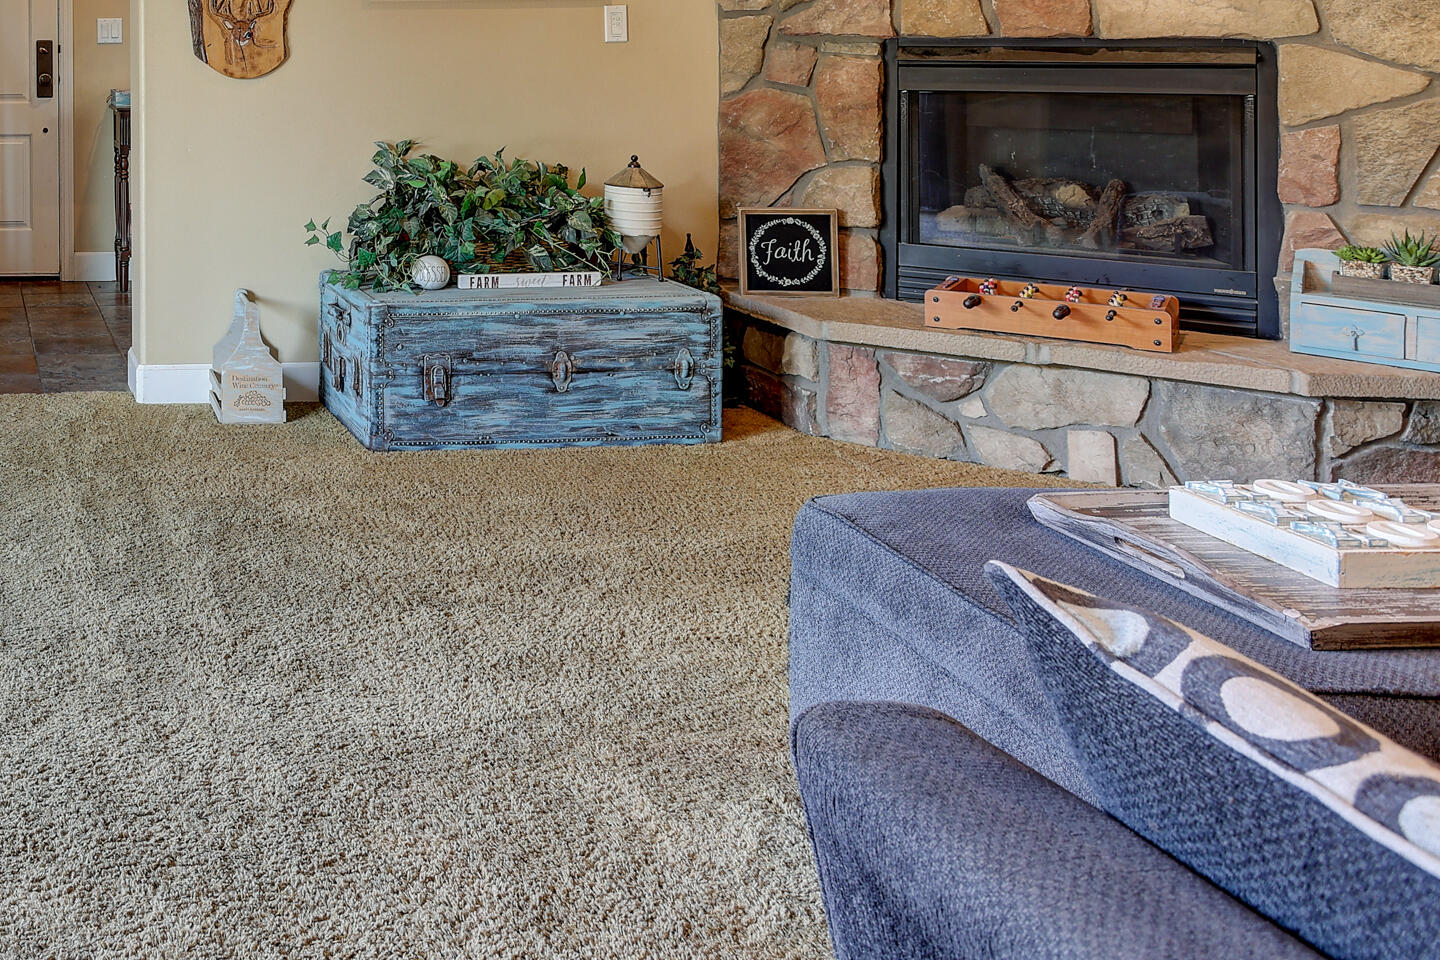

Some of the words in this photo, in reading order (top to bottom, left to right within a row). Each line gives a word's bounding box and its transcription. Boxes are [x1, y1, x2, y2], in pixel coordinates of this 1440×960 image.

[760, 238, 815, 265] Faith
[469, 276, 499, 289] FARM
[514, 274, 548, 288] sweet
[562, 274, 592, 287] FARM
